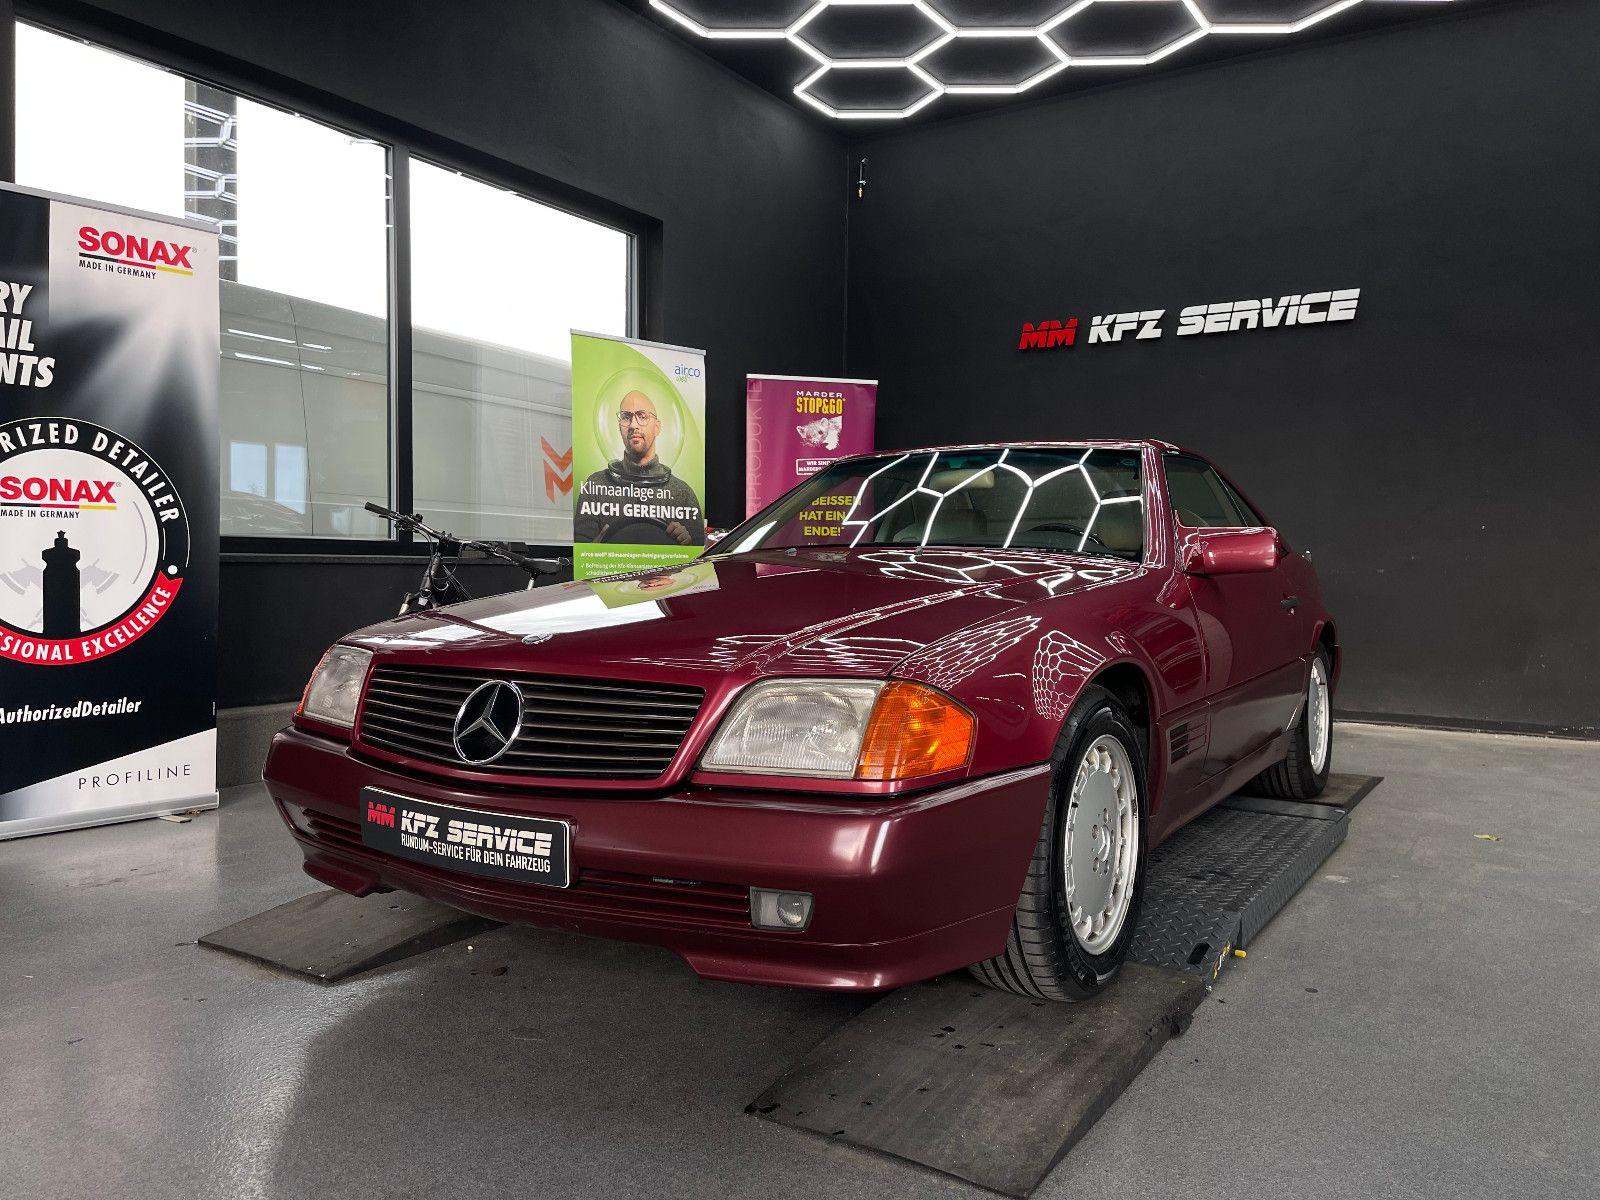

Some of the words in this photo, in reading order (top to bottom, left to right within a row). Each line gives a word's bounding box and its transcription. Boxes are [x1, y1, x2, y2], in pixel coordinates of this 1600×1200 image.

[79, 259, 102, 271] MADE
[105, 263, 114, 273] IN
[117, 266, 156, 280] GERMANY
[1019, 318, 1078, 350] MM
[1088, 309, 1166, 344] KFZ
[1176, 288, 1361, 336] SERVICE
[675, 363, 701, 378] airco
[796, 390, 843, 399] MARDER
[796, 397, 843, 415] STOP&GO
[0, 423, 79, 453] RIZED
[92, 431, 180, 523] DETAILER
[580, 480, 654, 502] Klimaanlage
[656, 488, 674, 500] an.
[0, 509, 24, 518] MADE
[27, 510, 36, 518] IN
[40, 510, 80, 519] GERMANY
[580, 501, 620, 517] AUCH
[623, 503, 699, 520] GEREINIGT?
[799, 510, 823, 521] HAT
[82, 586, 171, 658] EXCELLENCE
[78, 764, 191, 790] PROFILINE
[367, 800, 396, 829] MM
[401, 809, 442, 839] KFZ
[446, 819, 553, 857] SERVICE
[401, 833, 464, 860] RUNDUM-SERVICE
[465, 845, 482, 864] FÜR
[483, 851, 503, 867] DEIN
[505, 853, 551, 874] FAHRZEUG
